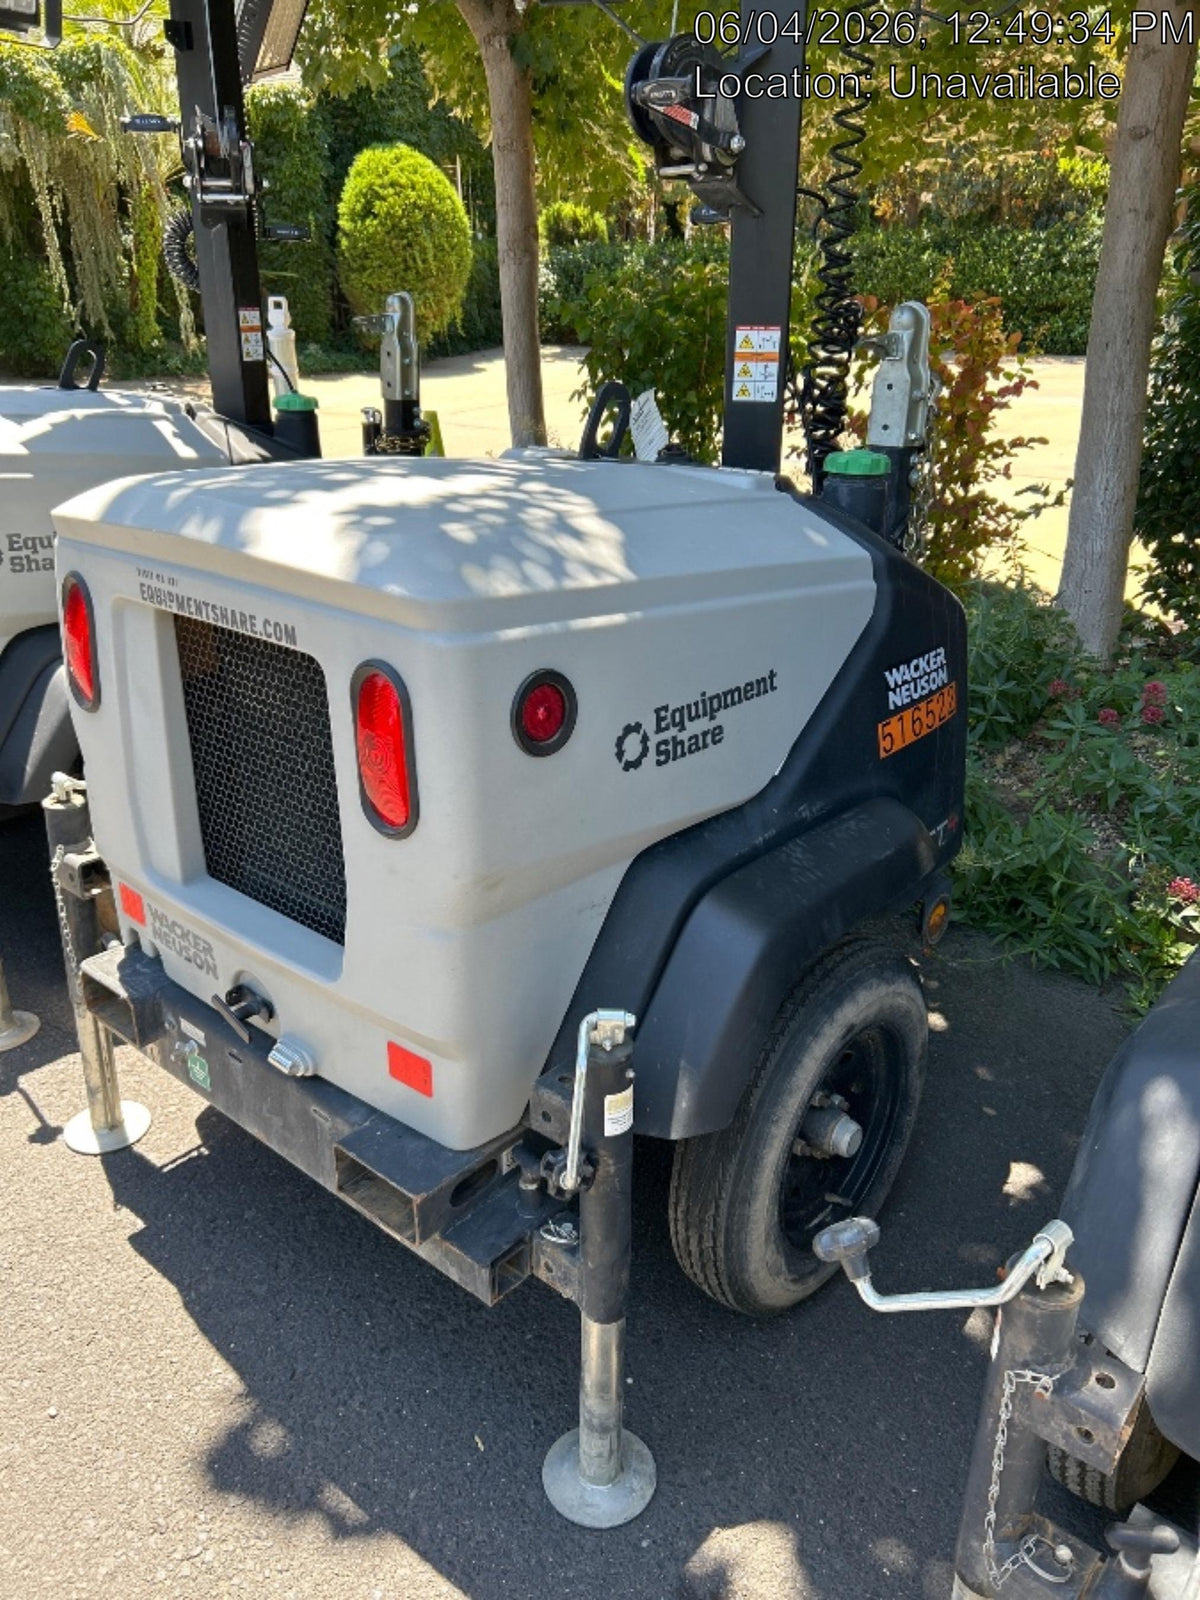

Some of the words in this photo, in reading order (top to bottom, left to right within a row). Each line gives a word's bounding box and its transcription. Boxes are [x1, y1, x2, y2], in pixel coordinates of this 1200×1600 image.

[884, 646, 947, 689] WACKER
[888, 664, 949, 711] NEUSON
[654, 668, 778, 734] Equipment
[655, 724, 724, 767] Share
[147, 902, 216, 962] WACKER
[151, 922, 219, 980] NEUSON
